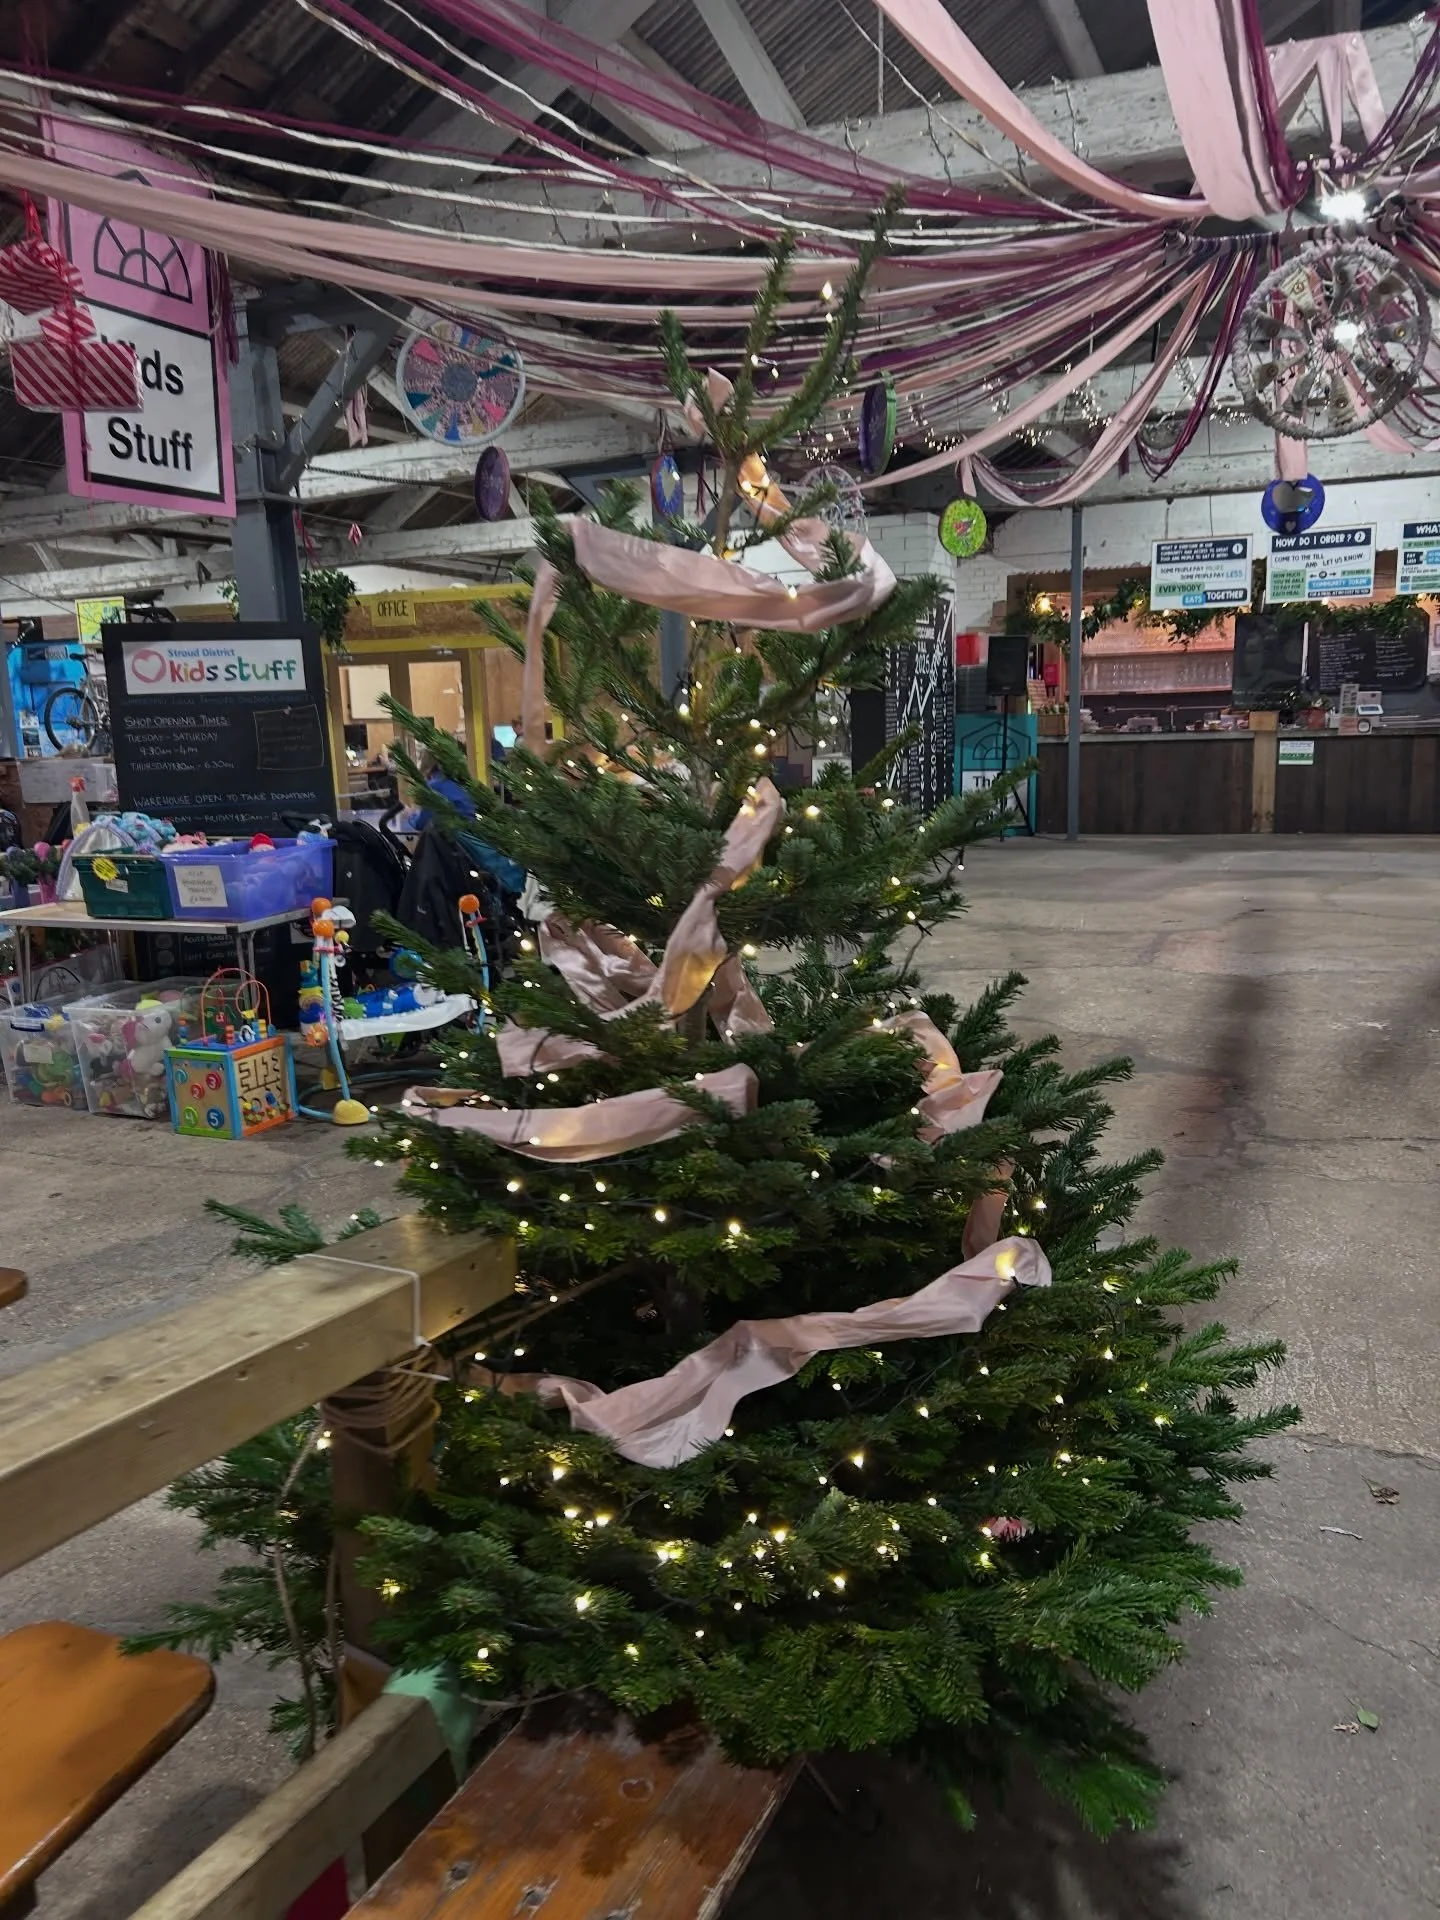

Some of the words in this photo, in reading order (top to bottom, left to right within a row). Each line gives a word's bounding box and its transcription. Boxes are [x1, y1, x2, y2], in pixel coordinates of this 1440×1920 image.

[108, 417, 194, 471] Stuff
[1275, 537, 1296, 548] HOW
[1299, 537, 1310, 546] DO
[1320, 534, 1345, 544] ORDER
[1344, 553, 1363, 562] KNOW
[1226, 569, 1243, 578] LESS
[1159, 583, 1202, 593] EVERYBODY
[1207, 591, 1244, 601] TOGETHER
[377, 599, 409, 617] OFFICE
[168, 648, 200, 657] Stroud
[203, 648, 235, 657] District
[225, 656, 297, 682] stuff
[124, 716, 151, 727] SHOP
[154, 716, 195, 726] OPENING
[126, 734, 163, 743] TUESDAY
[173, 732, 218, 742] SATURDAY
[133, 795, 190, 808] WAREHOUSE
[195, 794, 222, 803] OPEN
[226, 794, 238, 802] TO
[241, 793, 265, 801] TAKE
[271, 792, 317, 801] DONATIONS
[208, 1076, 217, 1089] 3
[192, 1088, 200, 1099] 2
[185, 1111, 195, 1126] 4
[209, 1111, 219, 1127] 5
